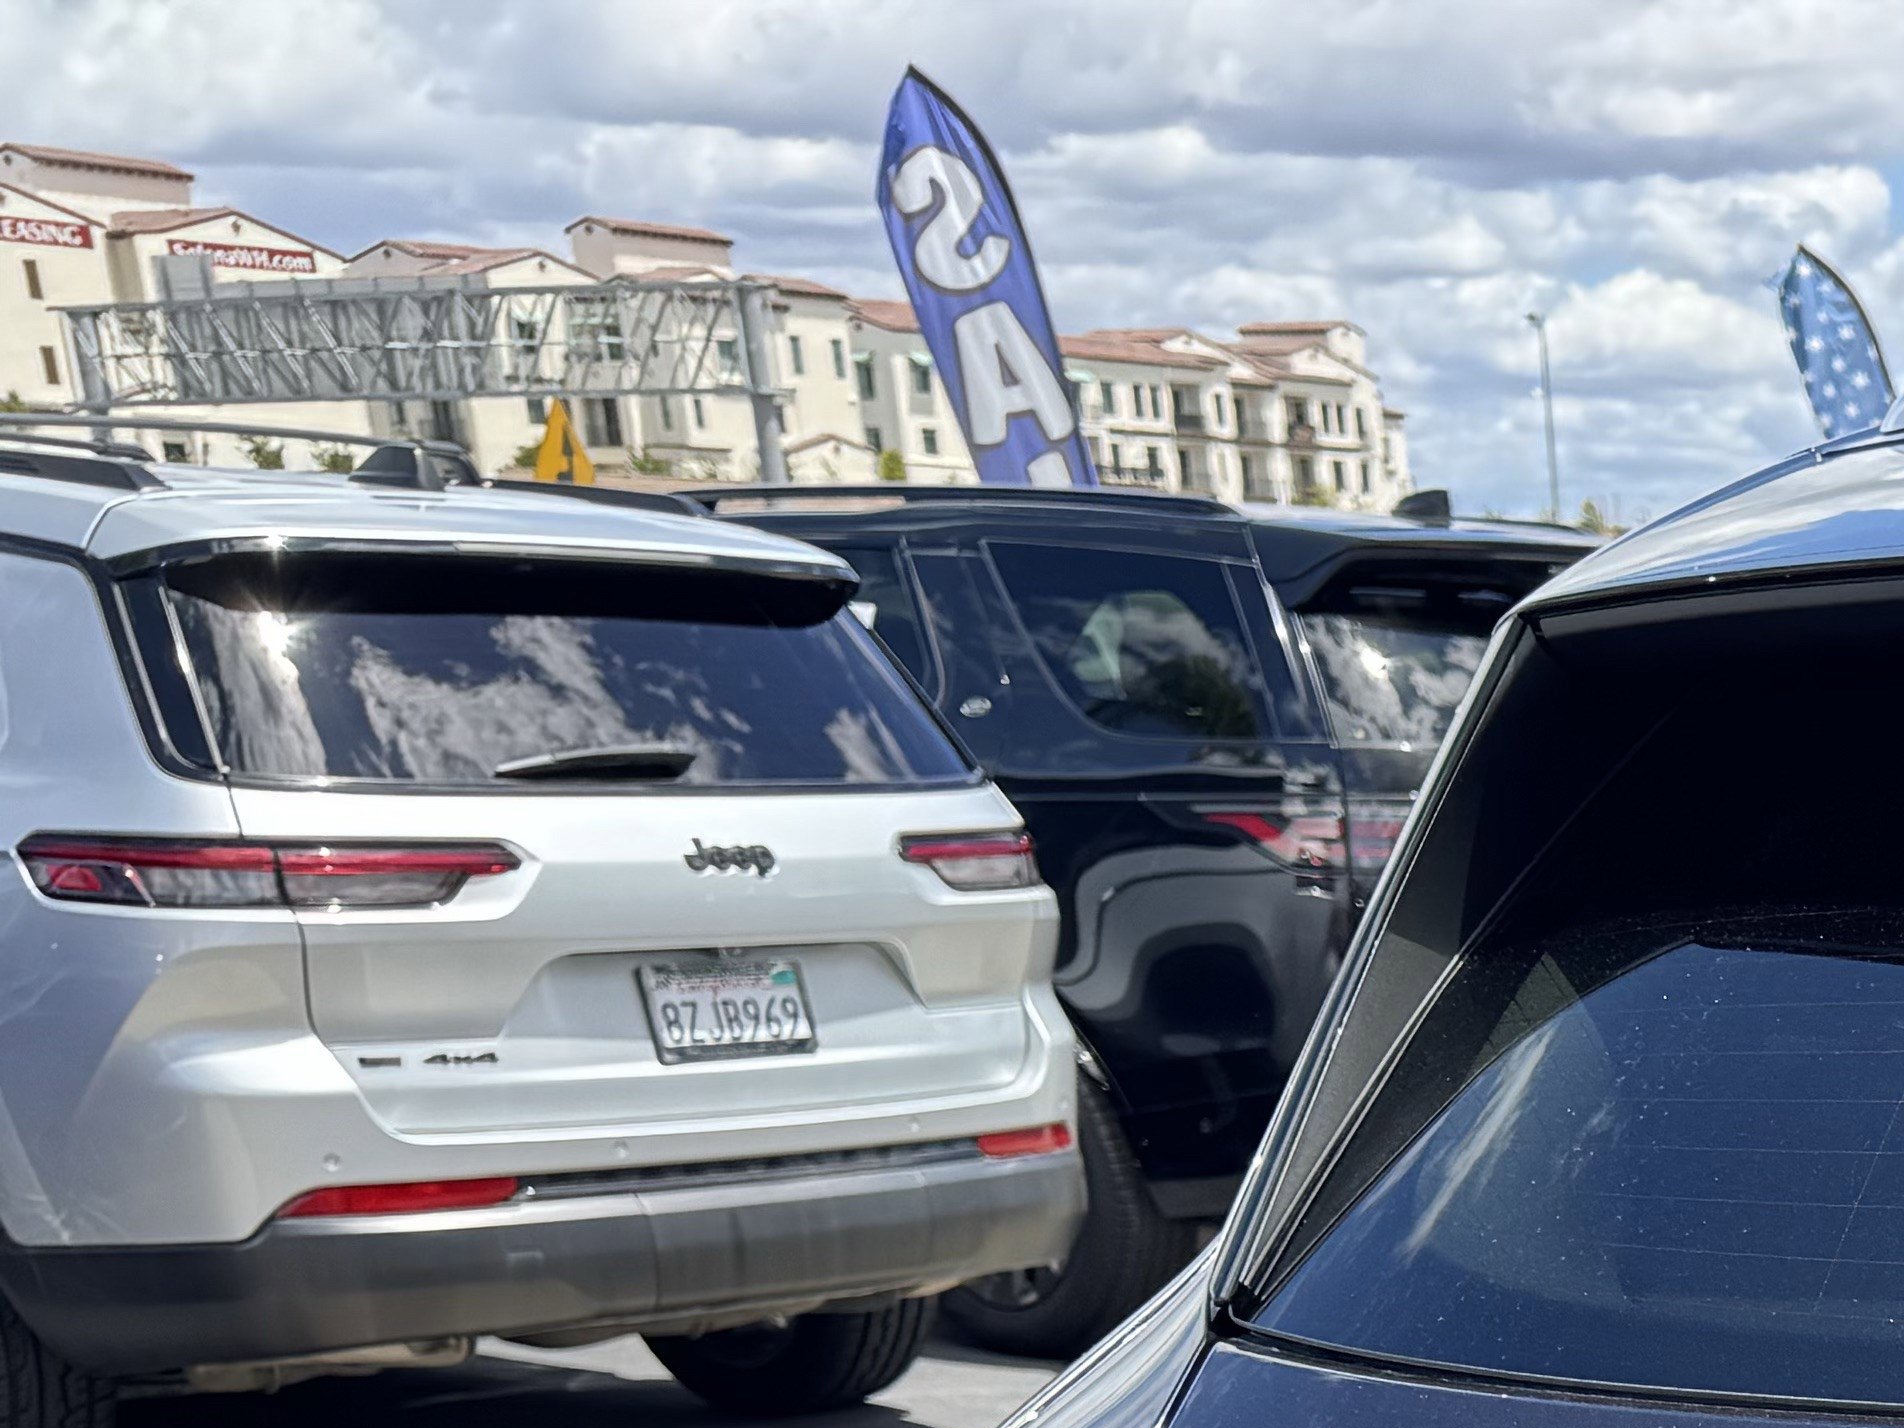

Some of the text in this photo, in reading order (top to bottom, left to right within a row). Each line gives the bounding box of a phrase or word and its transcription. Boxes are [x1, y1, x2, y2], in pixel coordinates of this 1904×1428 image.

[0, 218, 83, 247] EASING
[683, 838, 775, 877] Jeep
[662, 996, 799, 1042] 8ZJB969
